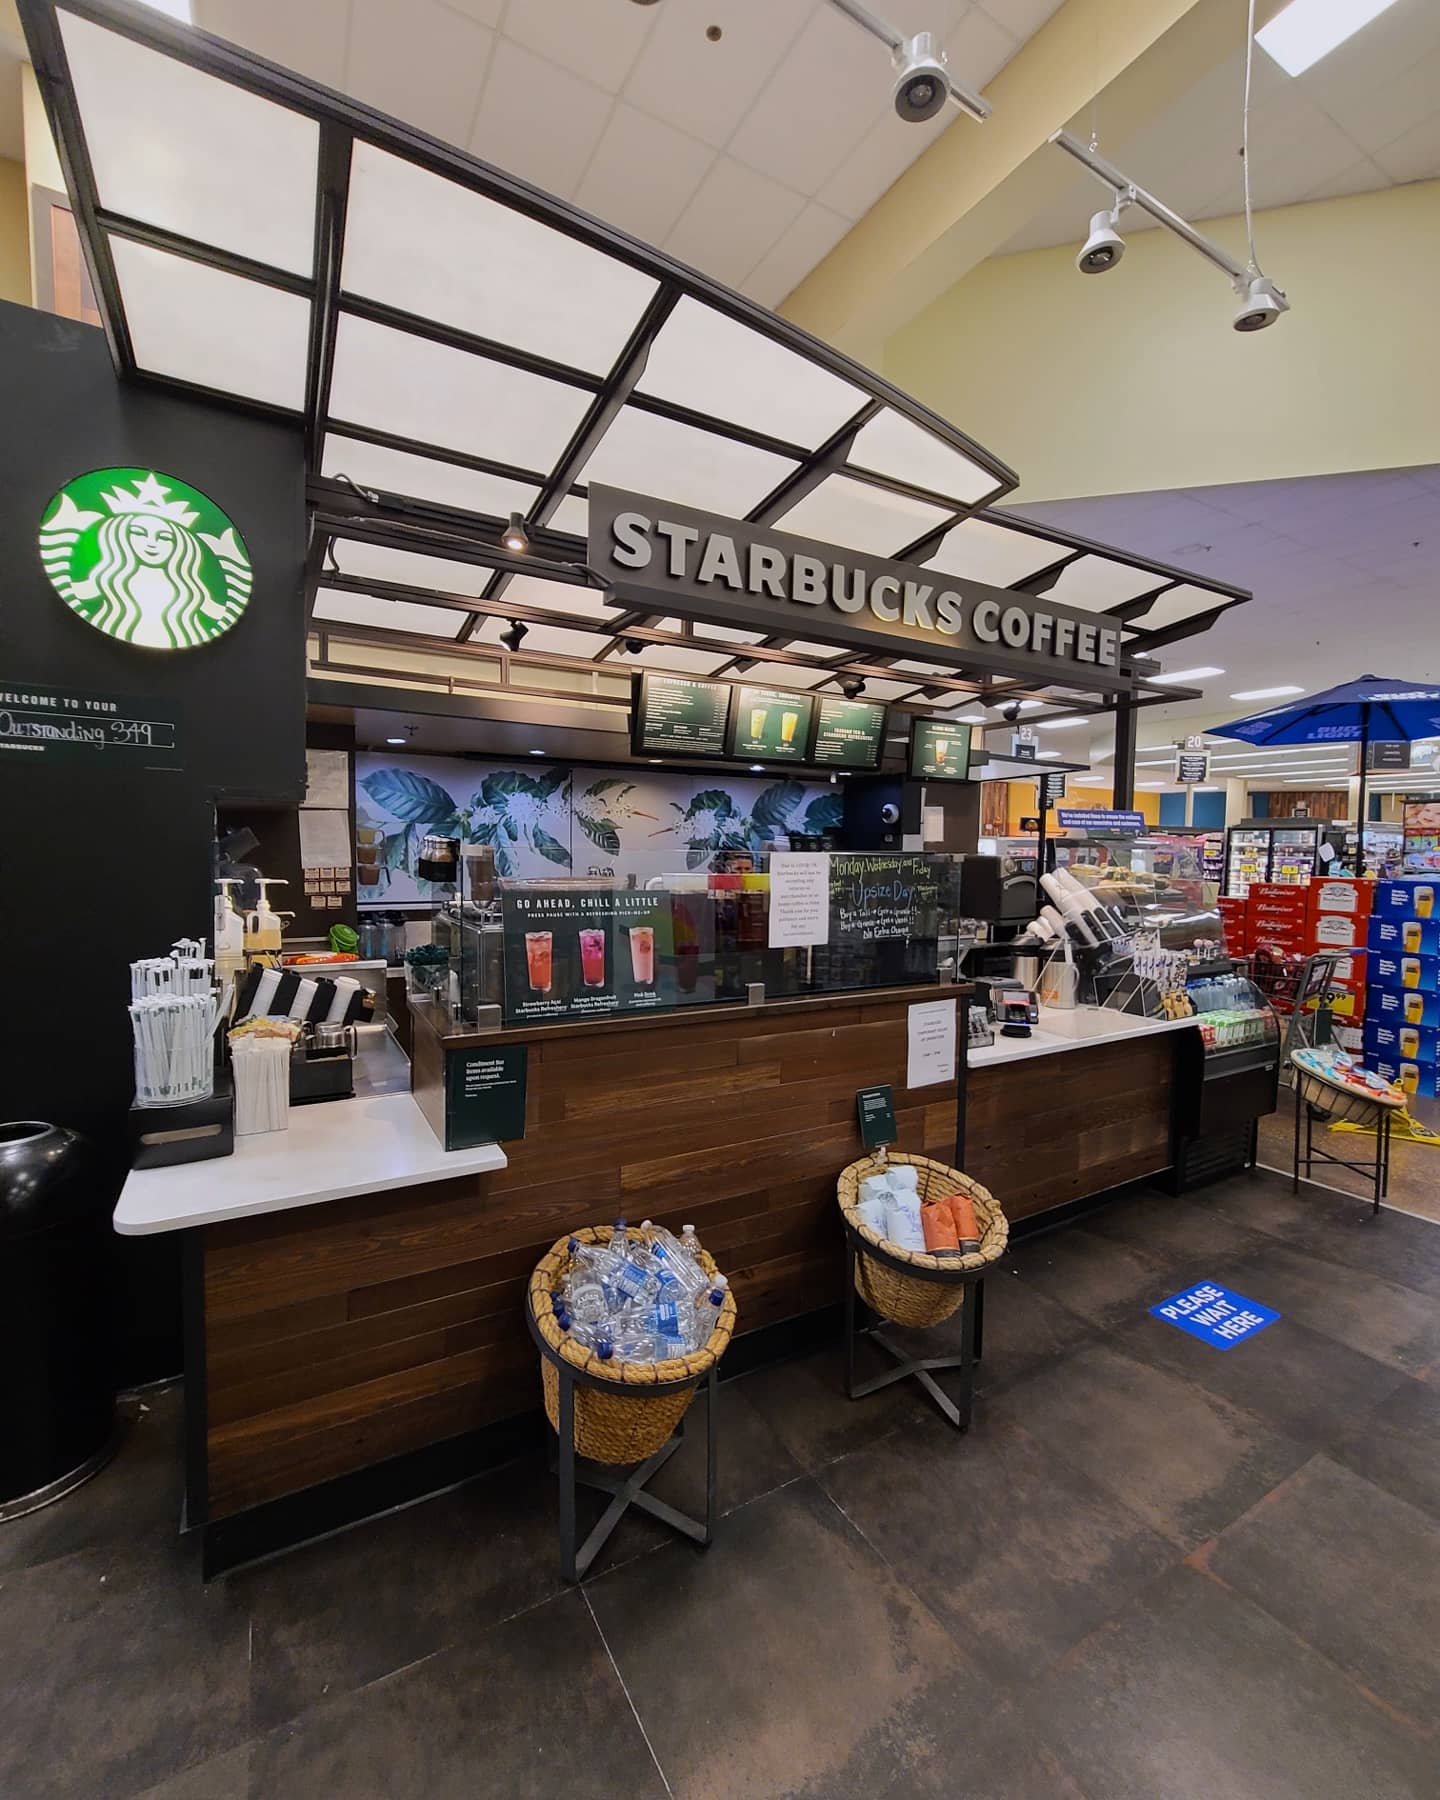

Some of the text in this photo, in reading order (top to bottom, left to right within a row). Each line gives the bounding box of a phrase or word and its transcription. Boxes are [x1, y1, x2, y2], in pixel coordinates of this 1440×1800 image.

[612, 511, 1119, 667] STARBUCKS COFFEE
[63, 698, 79, 709] TO
[85, 701, 117, 712] YOUR
[111, 721, 152, 745] 349
[1020, 727, 1032, 740] 23
[1307, 731, 1362, 739] LIGHT
[1187, 735, 1201, 748] 20
[893, 880, 914, 910] Day
[1258, 887, 1296, 897] Budweiser
[516, 897, 659, 909] GO AHEAD, CHILL A LITTLE
[1256, 903, 1294, 914] Budweiser
[1255, 920, 1293, 930] Budweiser
[1255, 936, 1293, 946] Budweiser
[1159, 1285, 1225, 1320] PLEASE
[1189, 1299, 1238, 1327] WAIT
[1212, 1310, 1265, 1340] HERE
